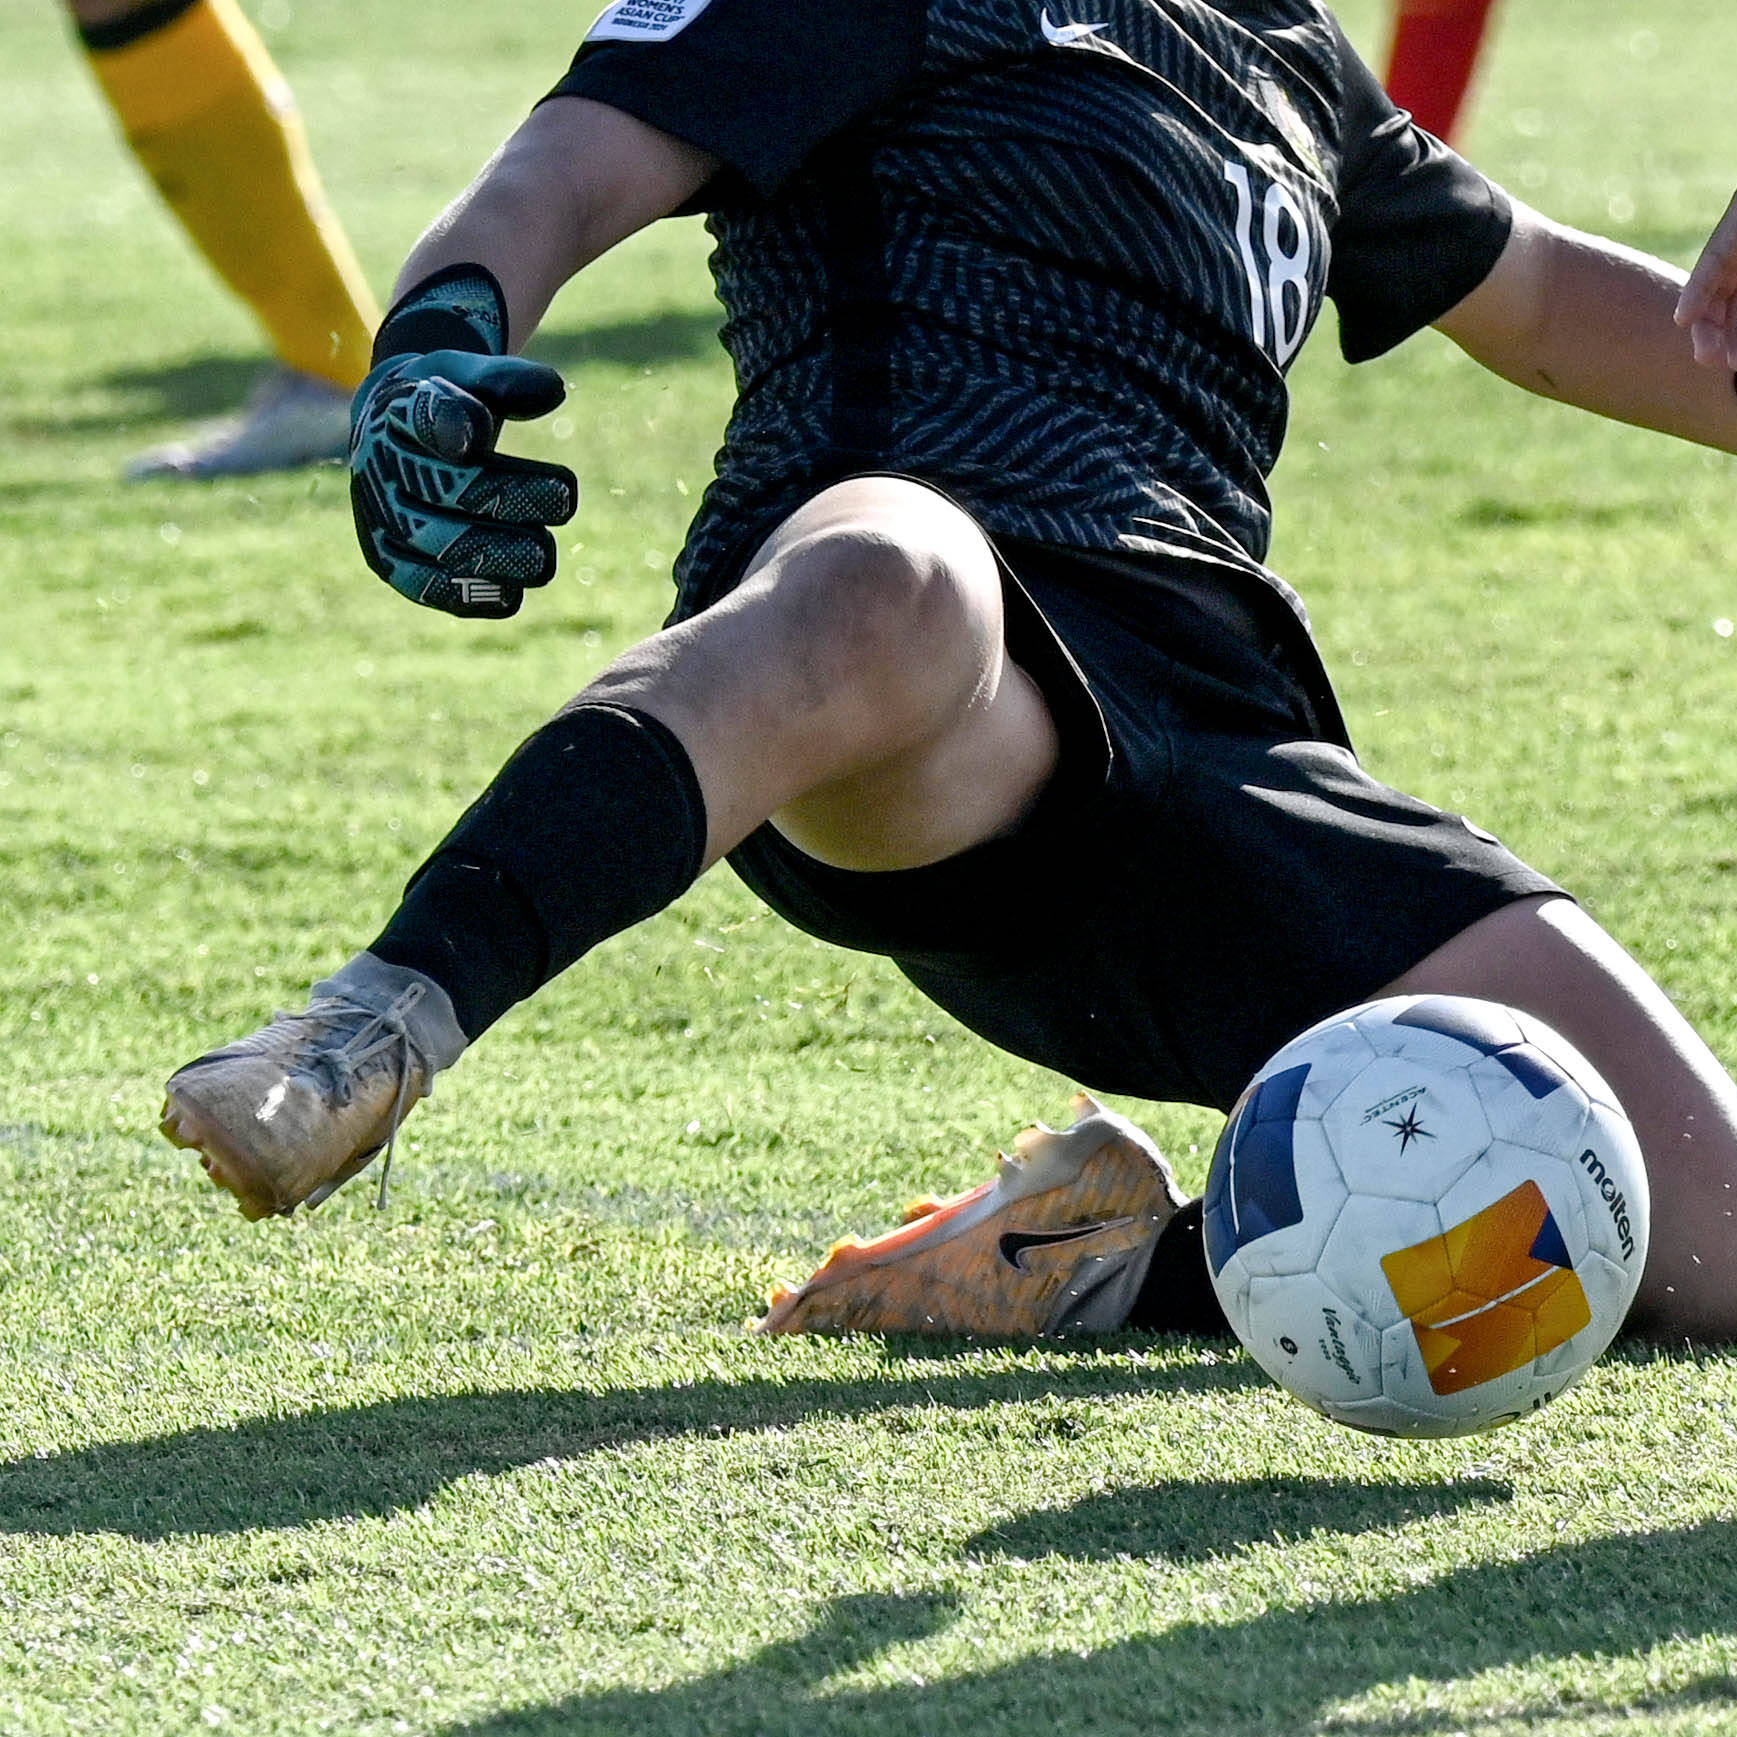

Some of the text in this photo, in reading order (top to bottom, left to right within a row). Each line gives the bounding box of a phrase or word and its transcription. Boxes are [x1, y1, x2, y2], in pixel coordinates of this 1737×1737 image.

[616, 7, 652, 20] ASIAN
[1224, 159, 1311, 369] 18
[1579, 1148, 1634, 1262] molten
